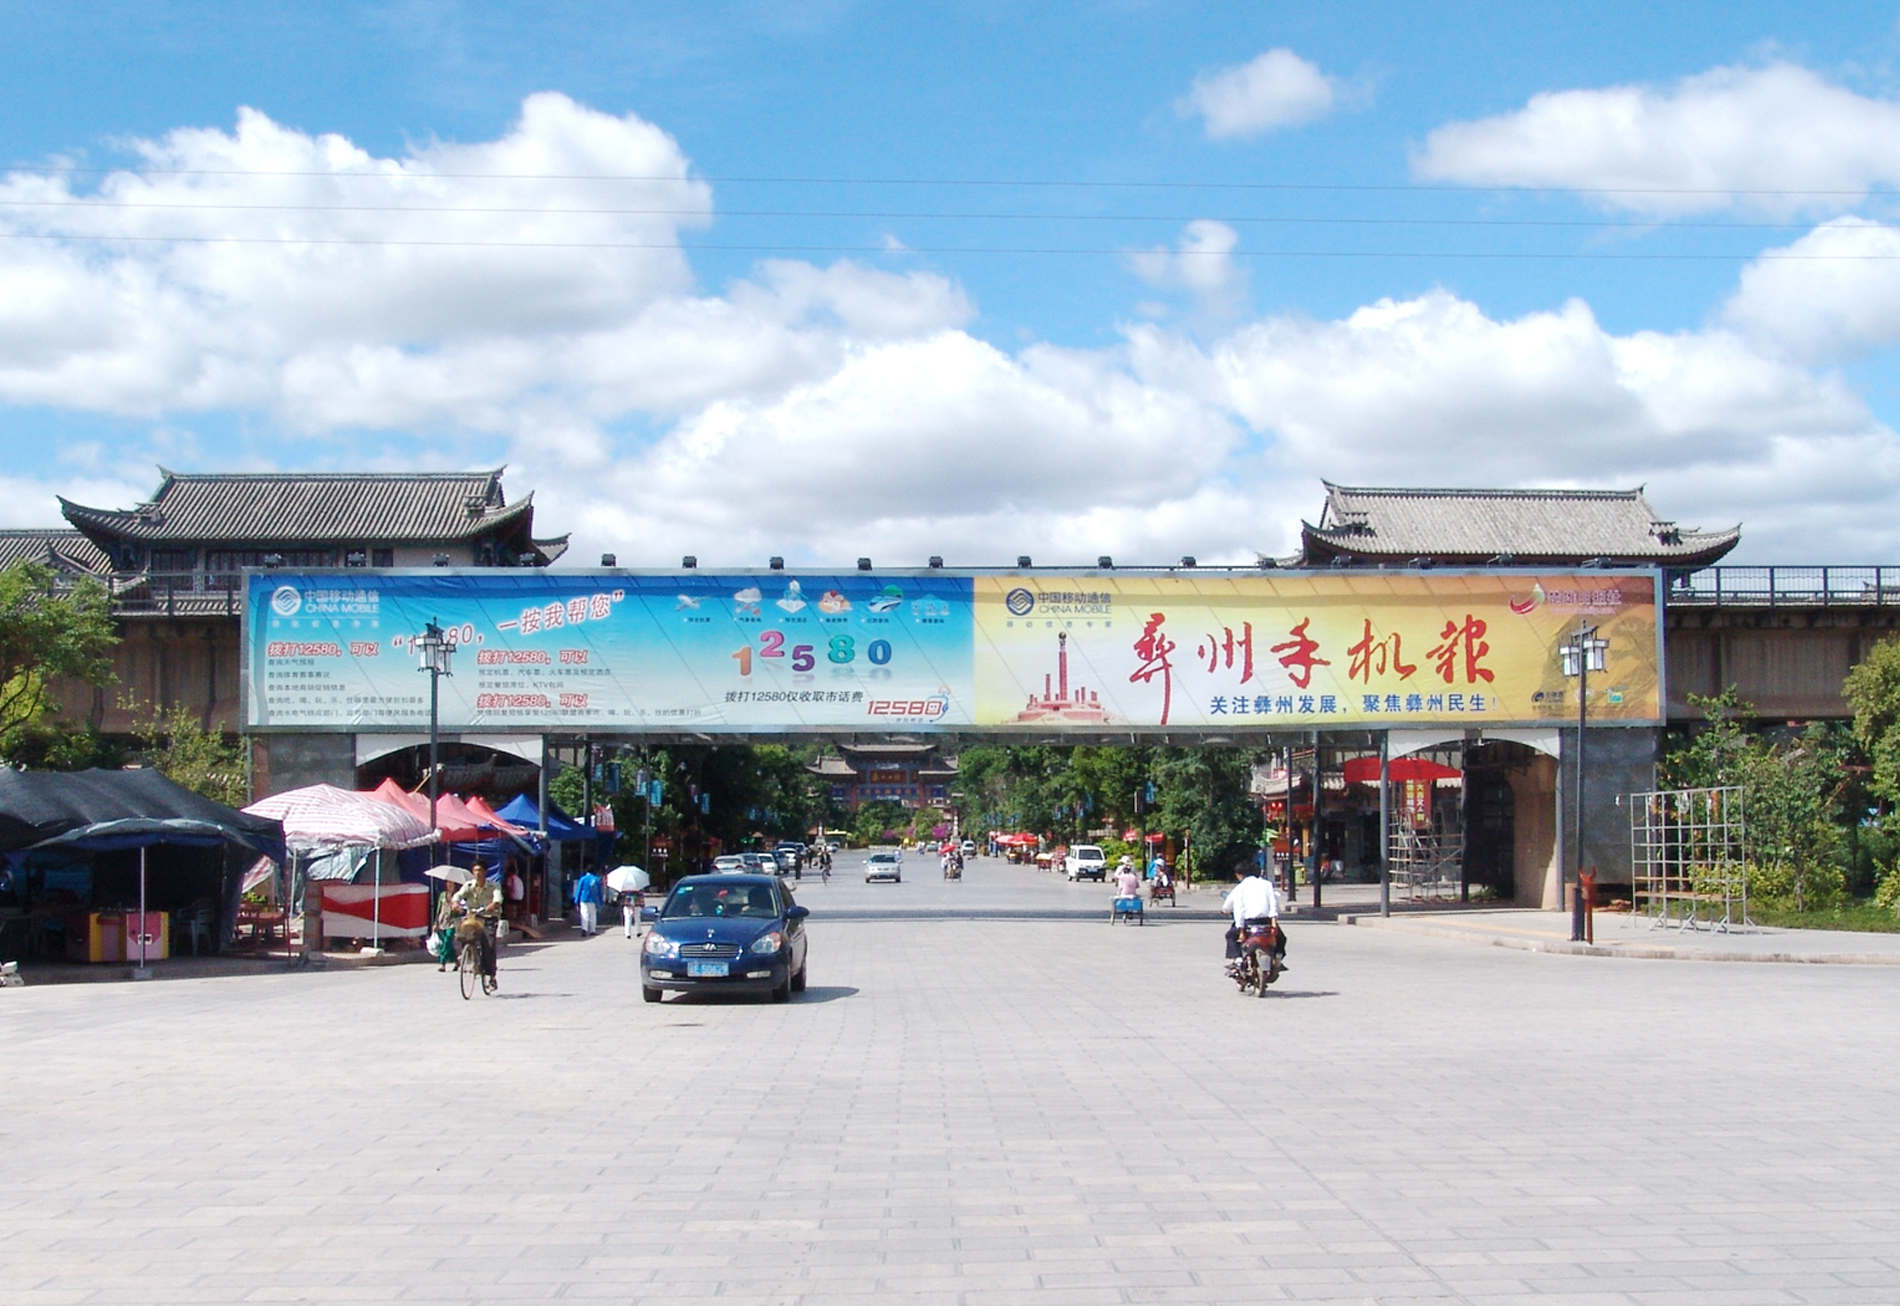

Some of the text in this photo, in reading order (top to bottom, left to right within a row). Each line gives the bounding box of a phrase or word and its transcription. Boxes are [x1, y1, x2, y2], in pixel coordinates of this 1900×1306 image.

[304, 589, 379, 603] 中国移动通信
[1038, 592, 1111, 604] 中国移动通信
[305, 603, 379, 613] CHINA MOBILE
[1039, 605, 1112, 613] CHINA MOBILE
[267, 642, 379, 657] 拨打12580，可以
[731, 630, 892, 676] 12580
[477, 650, 588, 665] 拨打12580，可以
[477, 694, 588, 708] 拨打12580，可以
[725, 691, 864, 703] 拨打12580仅收取市话费
[867, 700, 943, 716] 12580
